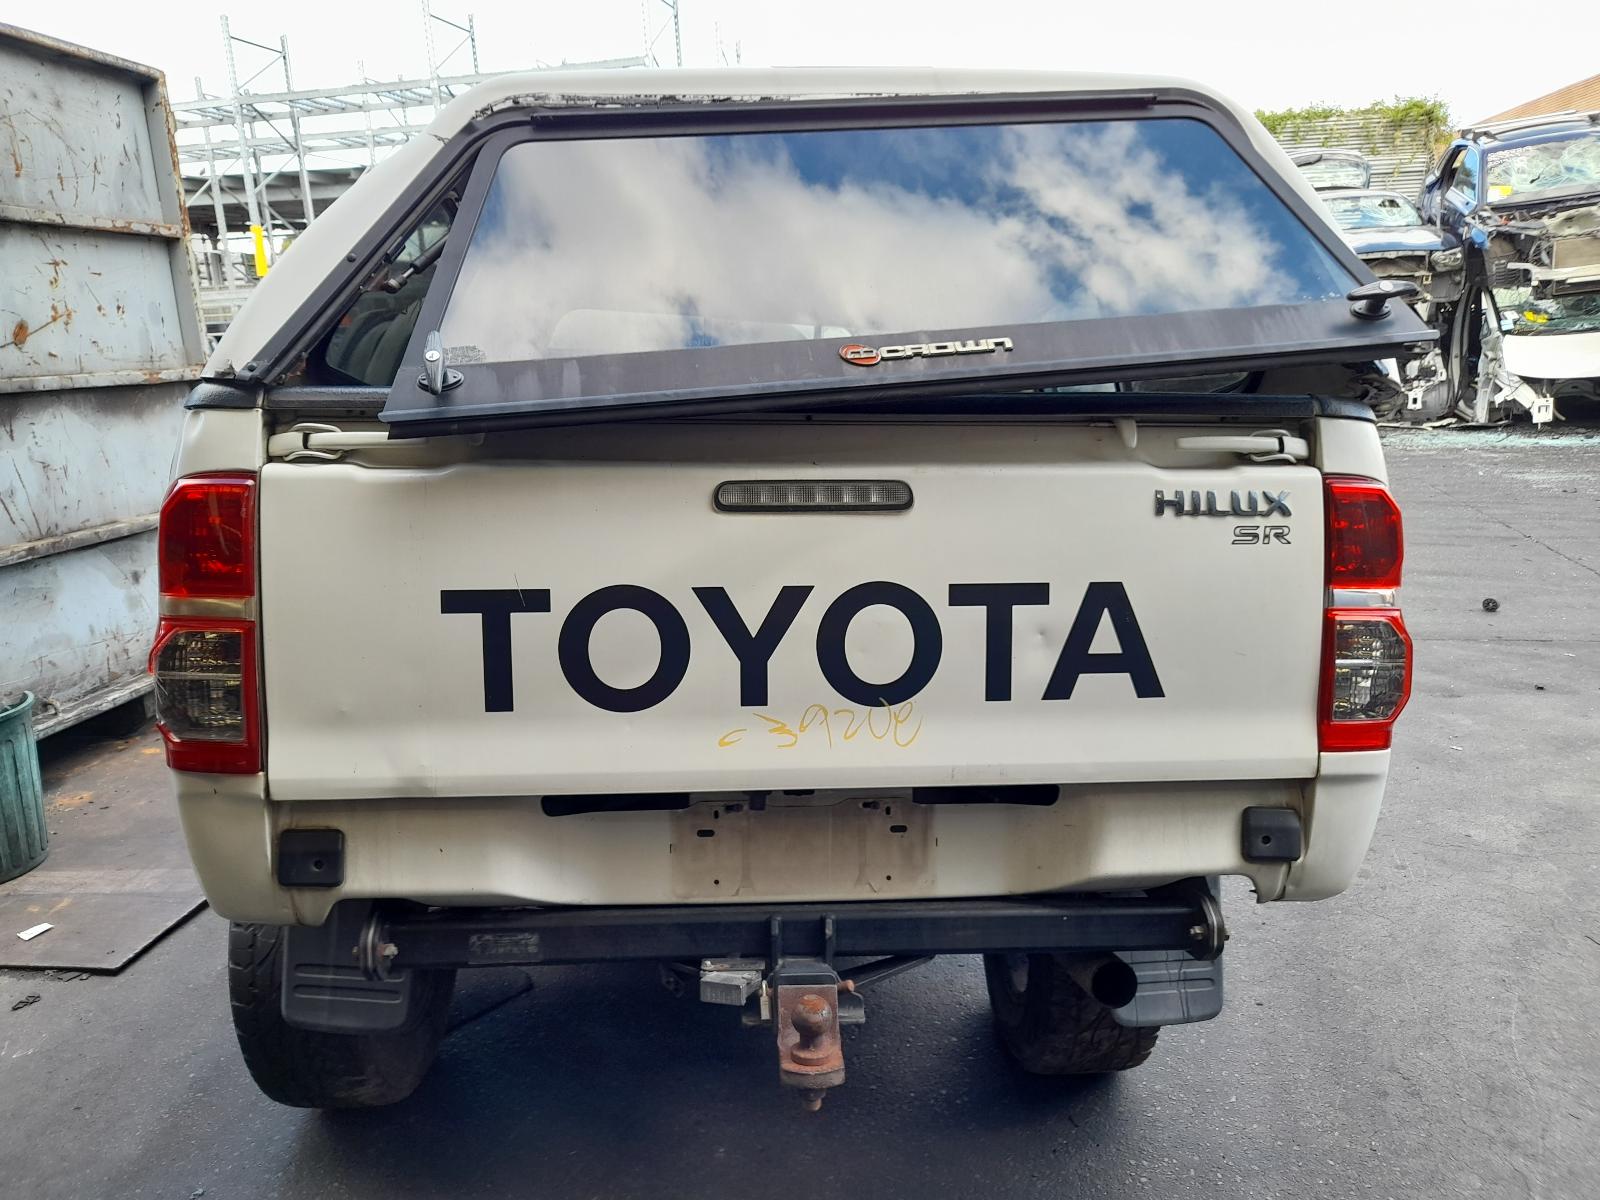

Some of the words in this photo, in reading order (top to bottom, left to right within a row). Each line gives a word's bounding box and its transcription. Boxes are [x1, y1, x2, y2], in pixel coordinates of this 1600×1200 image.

[1154, 489, 1292, 517] HILUX
[1232, 525, 1292, 545] SR
[440, 581, 1165, 713] TOYOTA
